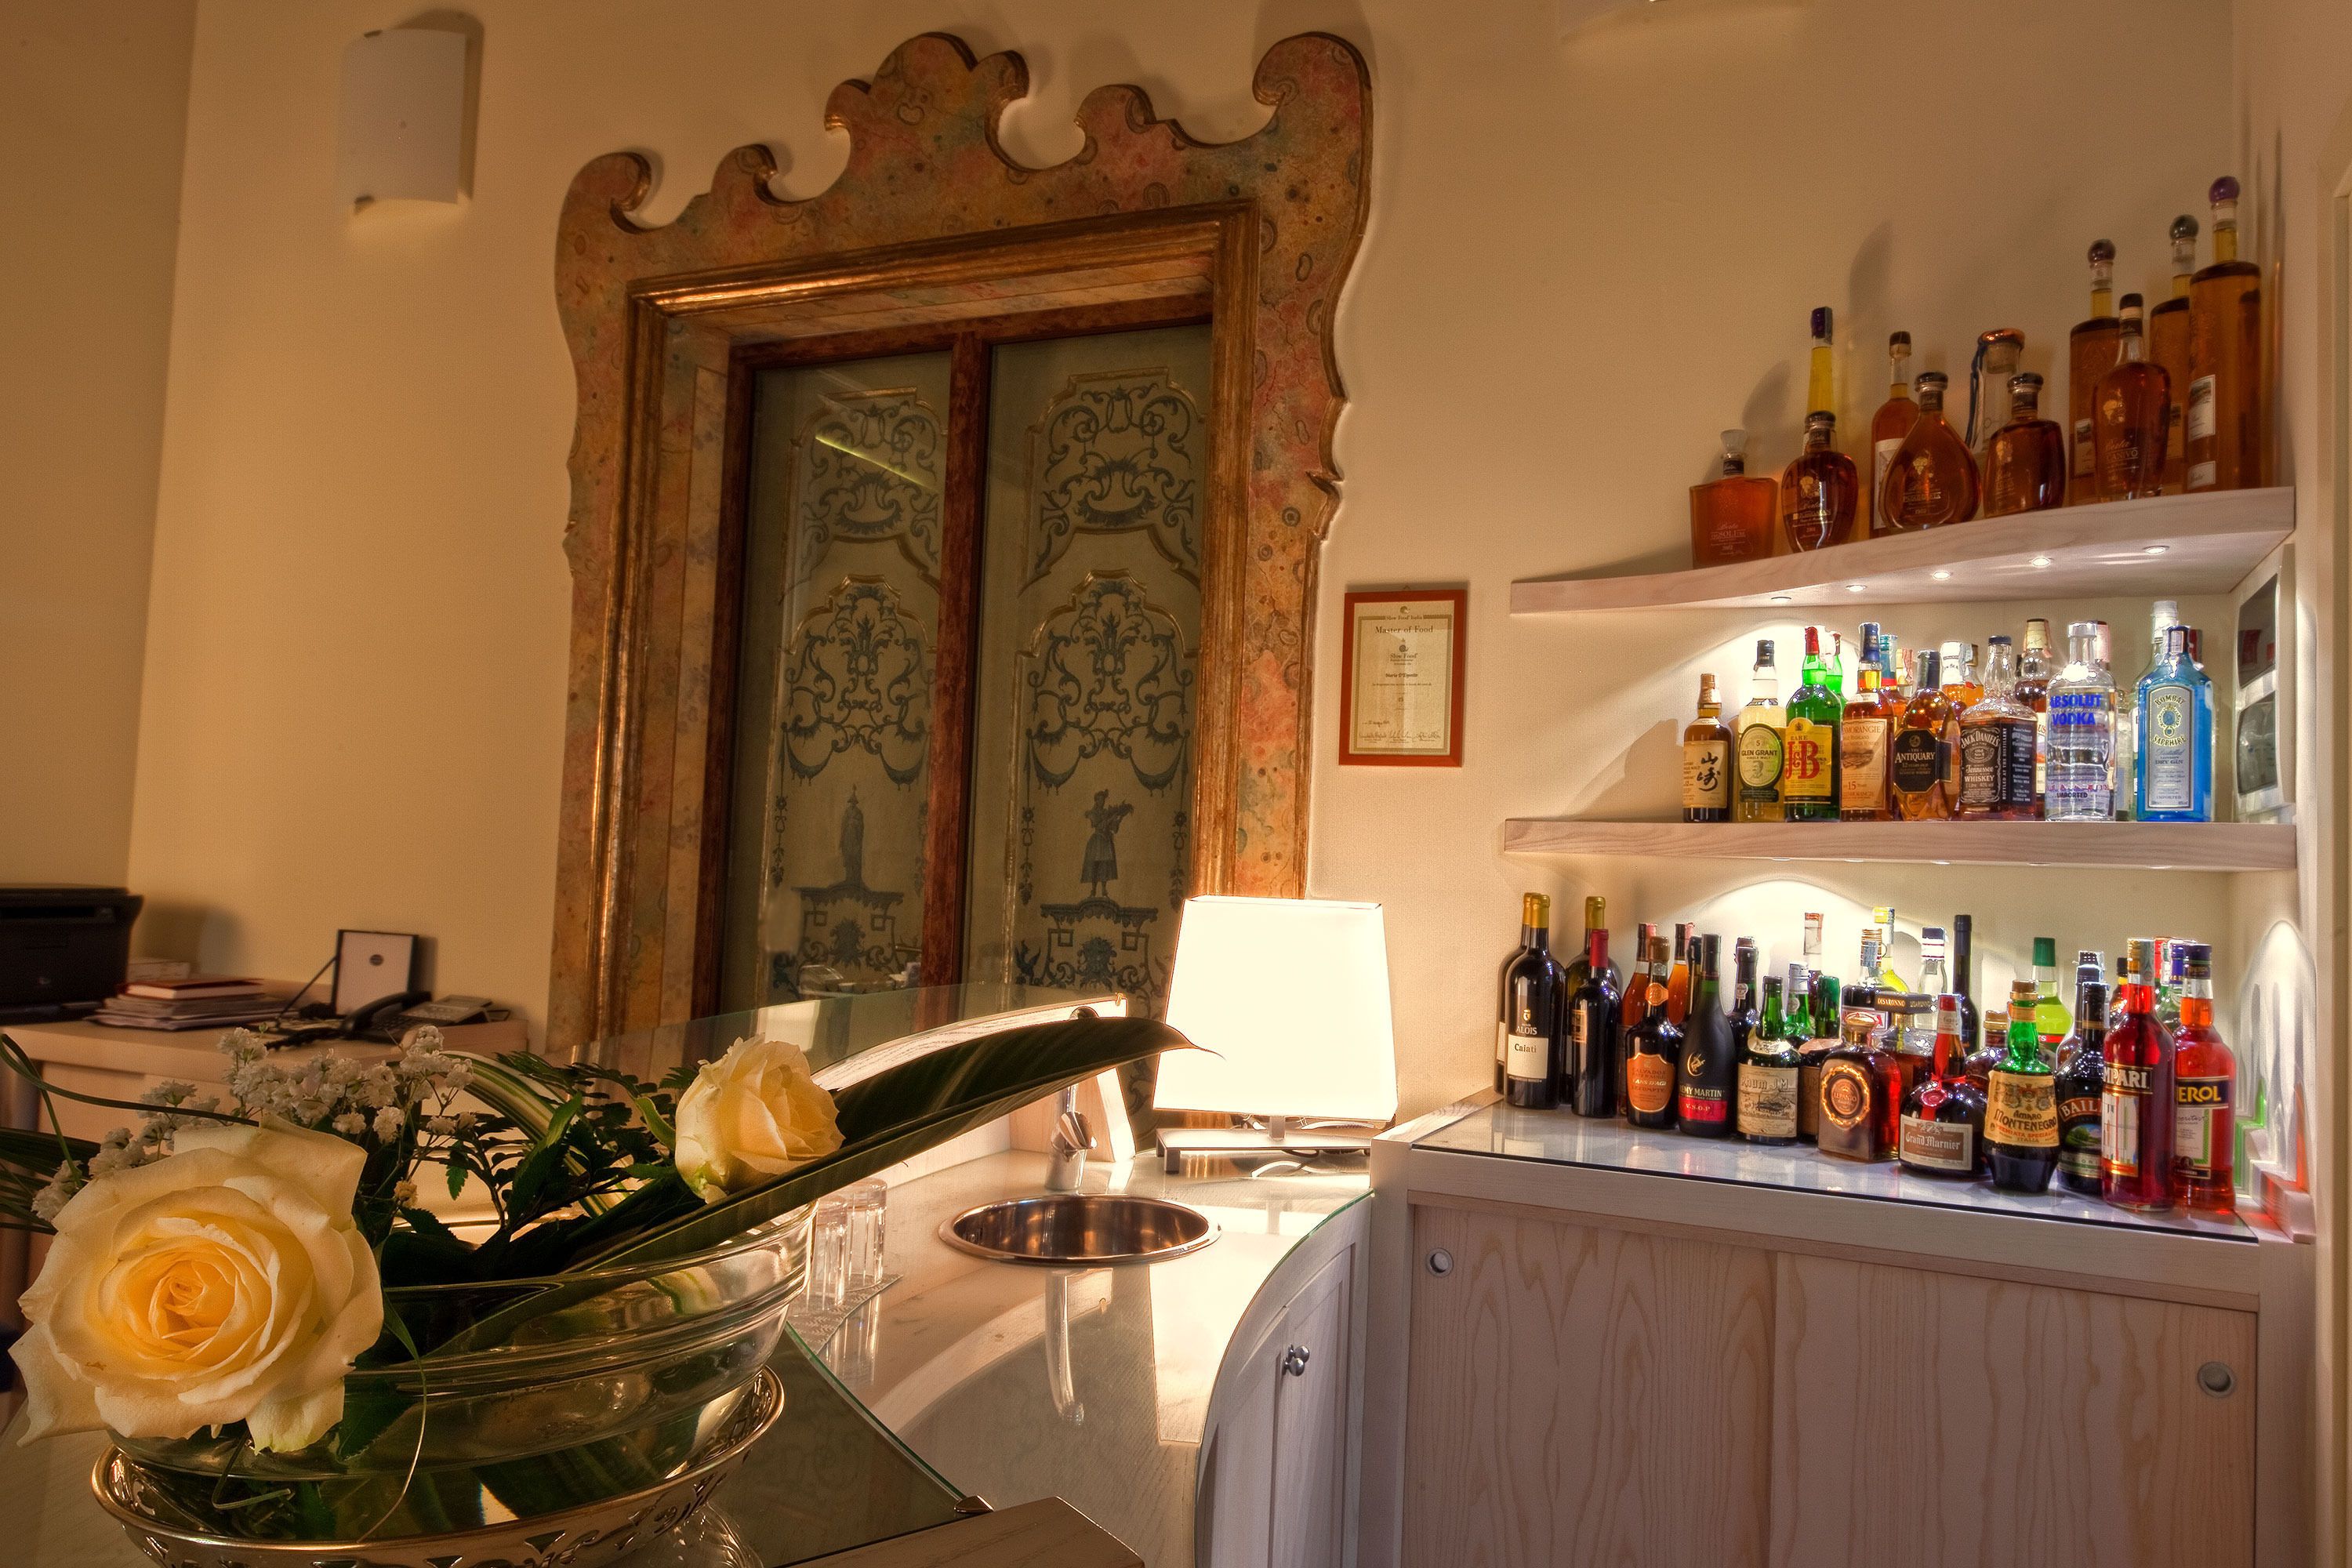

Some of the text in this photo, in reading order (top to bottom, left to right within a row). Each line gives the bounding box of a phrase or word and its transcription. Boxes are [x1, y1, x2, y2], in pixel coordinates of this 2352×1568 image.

[1414, 625, 1434, 633] Food
[2154, 695, 2187, 708] BOMBAY
[2052, 713, 2096, 725] VODKA
[1843, 725, 1882, 734] AMORANGIE
[1961, 731, 2001, 749] JACK DANIEL'S
[2152, 734, 2187, 746] SAPPHIRE
[1784, 740, 1820, 780] J&B
[1894, 752, 1936, 764] ANTIQUARY
[1965, 764, 1994, 773] Tennessee
[1848, 781, 1857, 790] 15
[1877, 997, 1906, 1007] DISARONNO
[1515, 1025, 1537, 1036] ALOIS
[1514, 1043, 1537, 1054] Caiati
[2103, 1065, 2147, 1089] MPARI
[1741, 1076, 1768, 1091] Rhum
[1694, 1087, 1722, 1098] MARTIN
[2177, 1085, 2222, 1103] EROL
[2061, 1099, 2101, 1116] BAIL
[1994, 1109, 2057, 1131] MONTENEGRO
[1906, 1131, 1961, 1150] Grand Marnier
